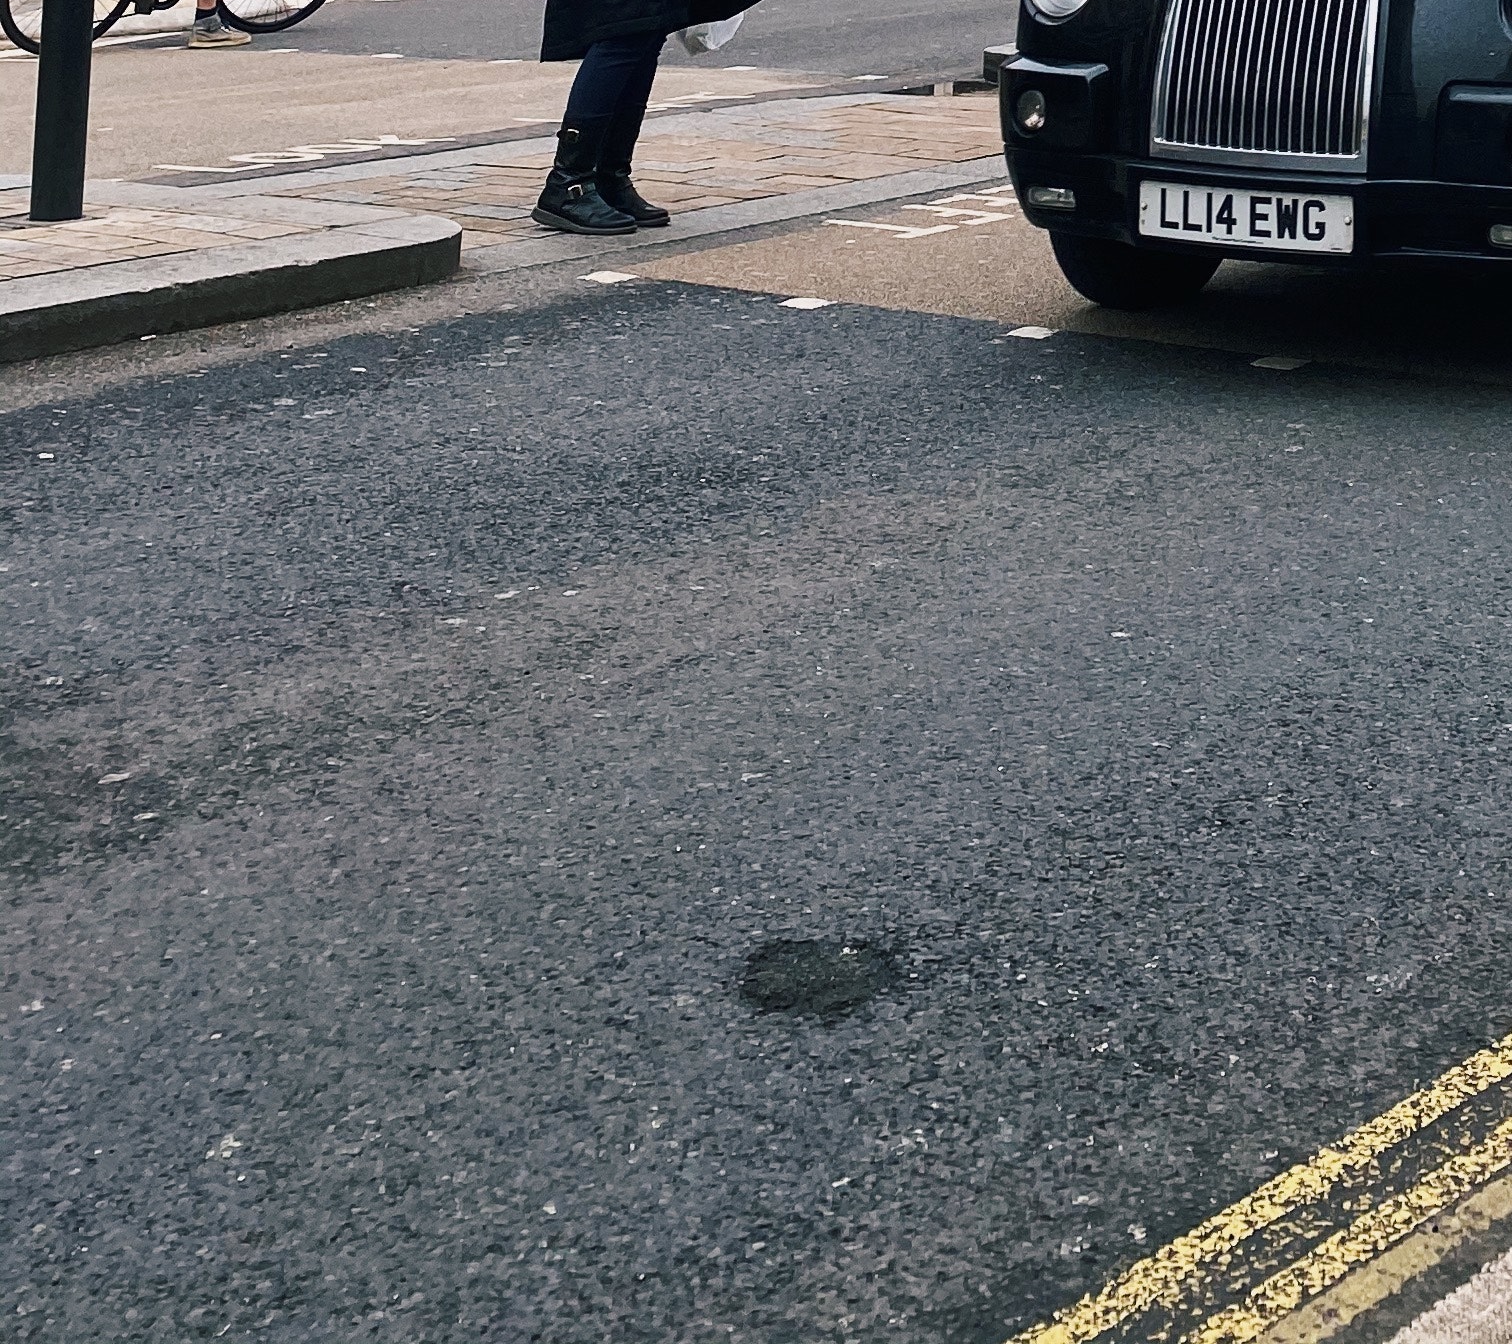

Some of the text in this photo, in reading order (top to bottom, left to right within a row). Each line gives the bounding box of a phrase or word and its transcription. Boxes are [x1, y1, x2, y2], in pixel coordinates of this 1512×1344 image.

[152, 134, 456, 174] LOOK
[1159, 187, 1327, 242] LL14 EWG
